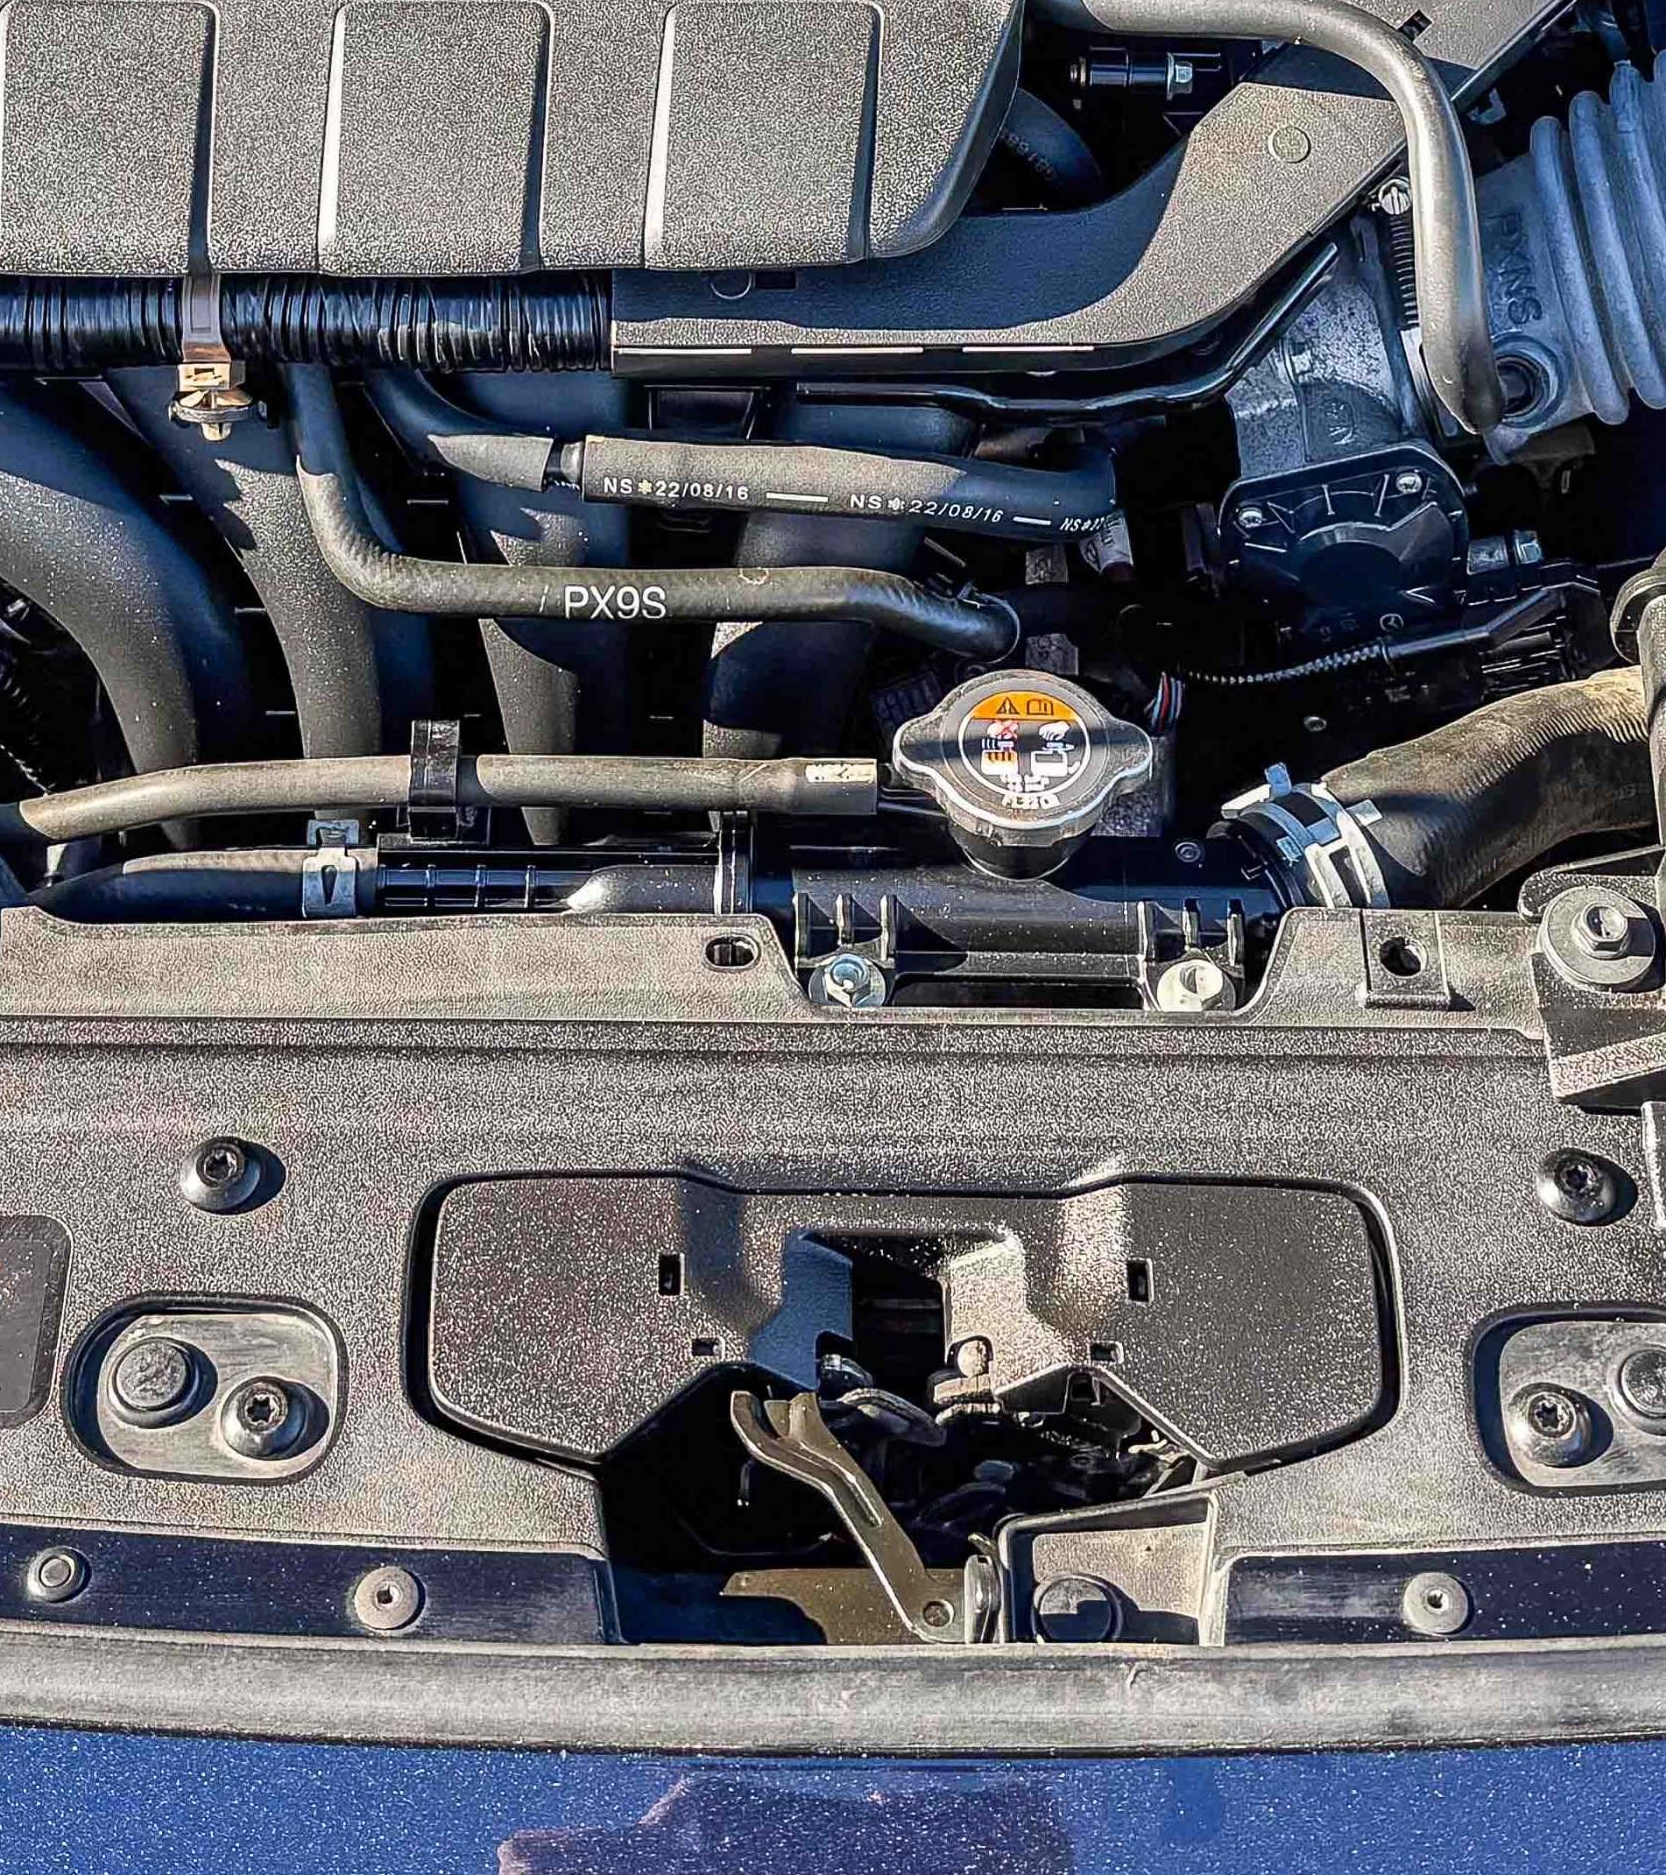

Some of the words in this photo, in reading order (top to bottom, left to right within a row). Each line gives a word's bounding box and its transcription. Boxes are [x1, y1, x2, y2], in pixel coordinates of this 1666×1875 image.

[602, 476, 633, 494] NS
[654, 480, 750, 502] 22/08/16
[849, 493, 883, 511] NS
[908, 499, 1005, 524] 22/08/16
[563, 584, 668, 620] PX9S
